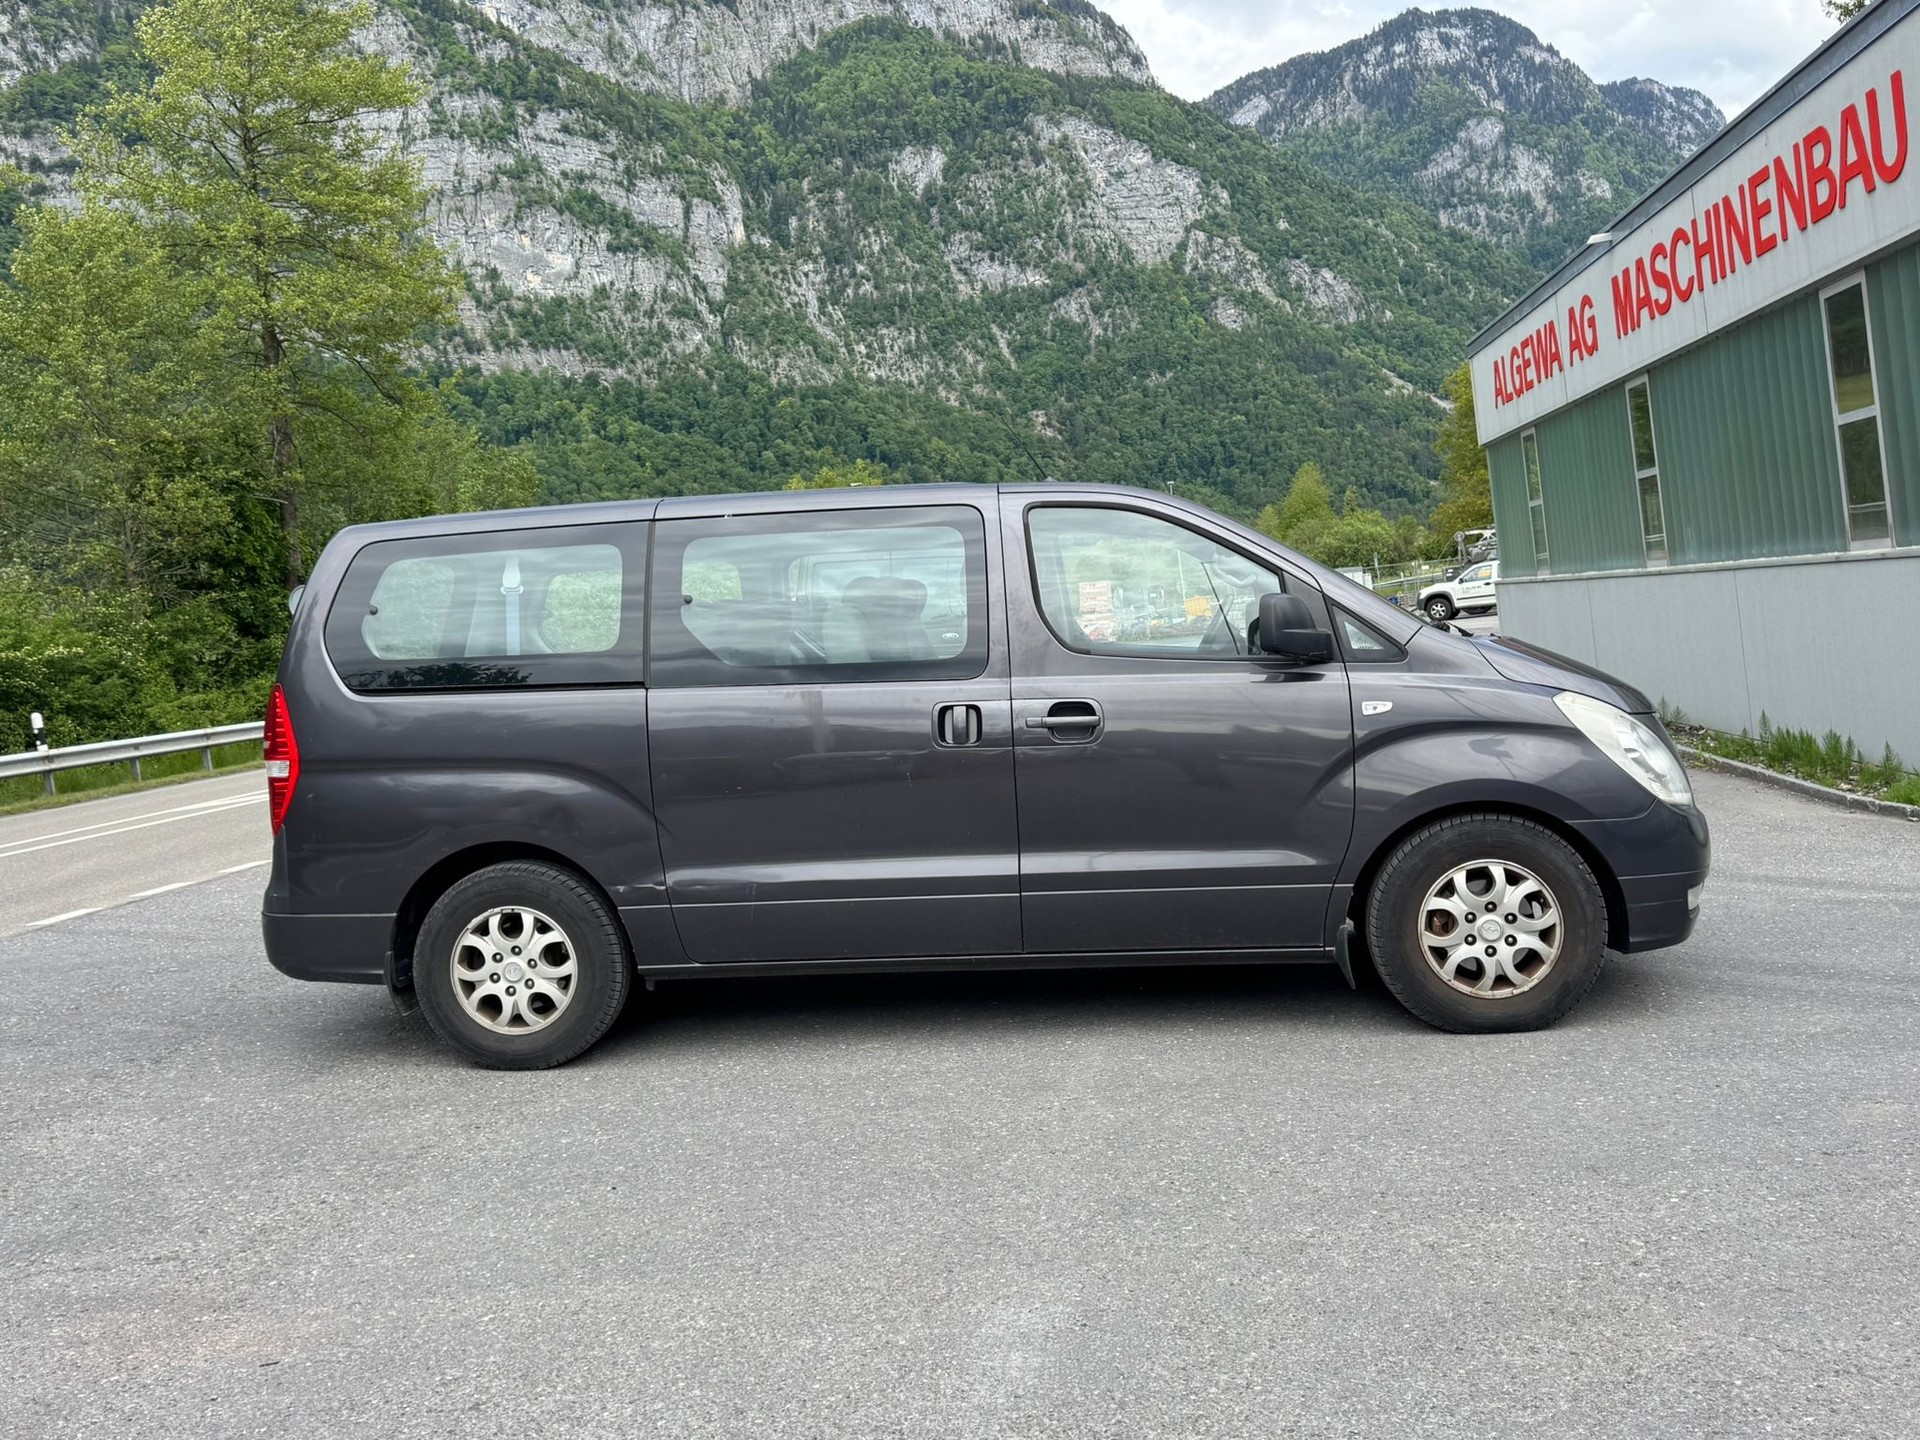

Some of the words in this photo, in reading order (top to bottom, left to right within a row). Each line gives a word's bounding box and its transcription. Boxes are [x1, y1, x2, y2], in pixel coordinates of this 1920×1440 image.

[1493, 320, 1563, 409] ALGEWA
[1568, 294, 1598, 367] AG
[1611, 69, 1908, 339] MASCHINENBAU
